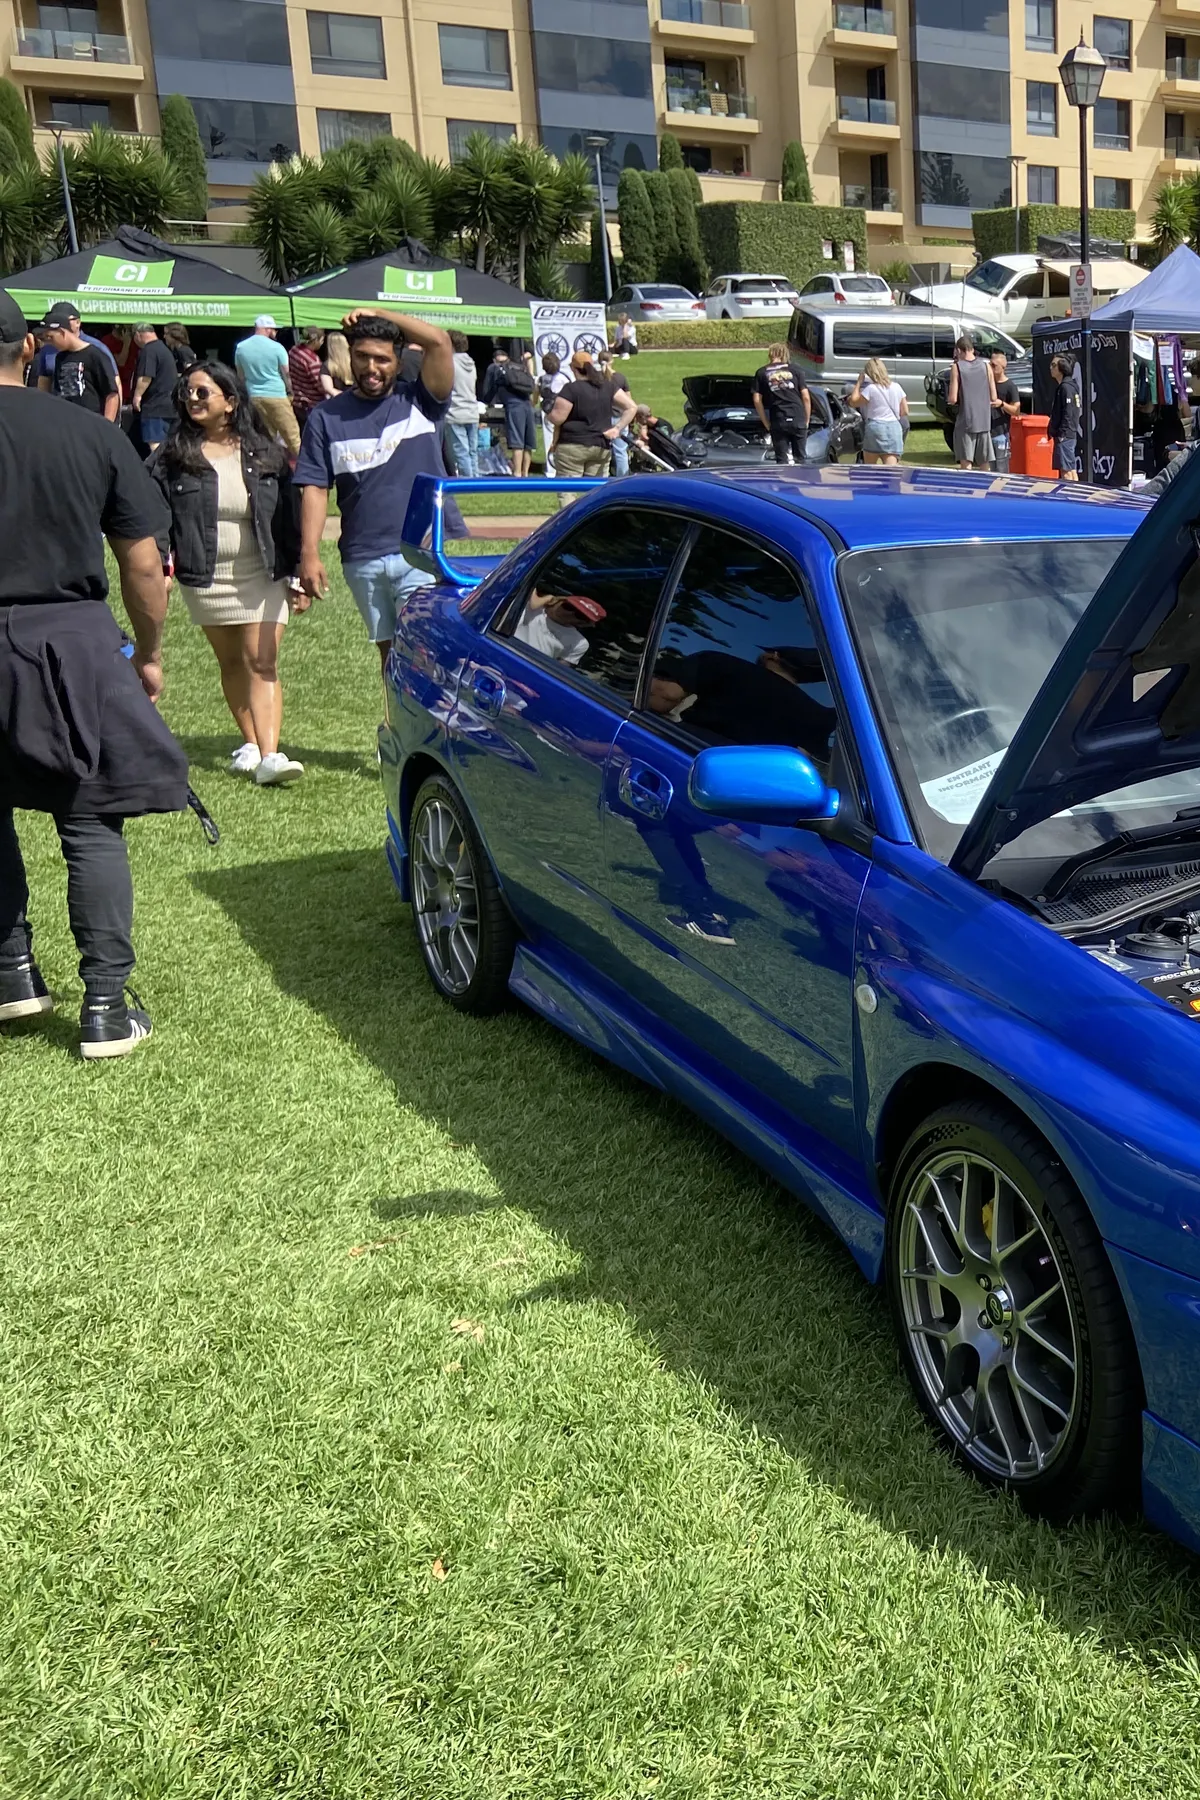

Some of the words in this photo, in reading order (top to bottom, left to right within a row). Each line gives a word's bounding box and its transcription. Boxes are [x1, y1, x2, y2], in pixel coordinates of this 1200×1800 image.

[115, 264, 148, 282] CI
[406, 272, 433, 291] CI
[48, 298, 230, 317] WW.CIPERFORMANCEPARTS.COM
[533, 305, 603, 320] COSMIS
[947, 761, 991, 783] ENTRANT
[1153, 967, 1200, 984] PROCESS
[1054, 1235, 1088, 1342] MICHELIN
